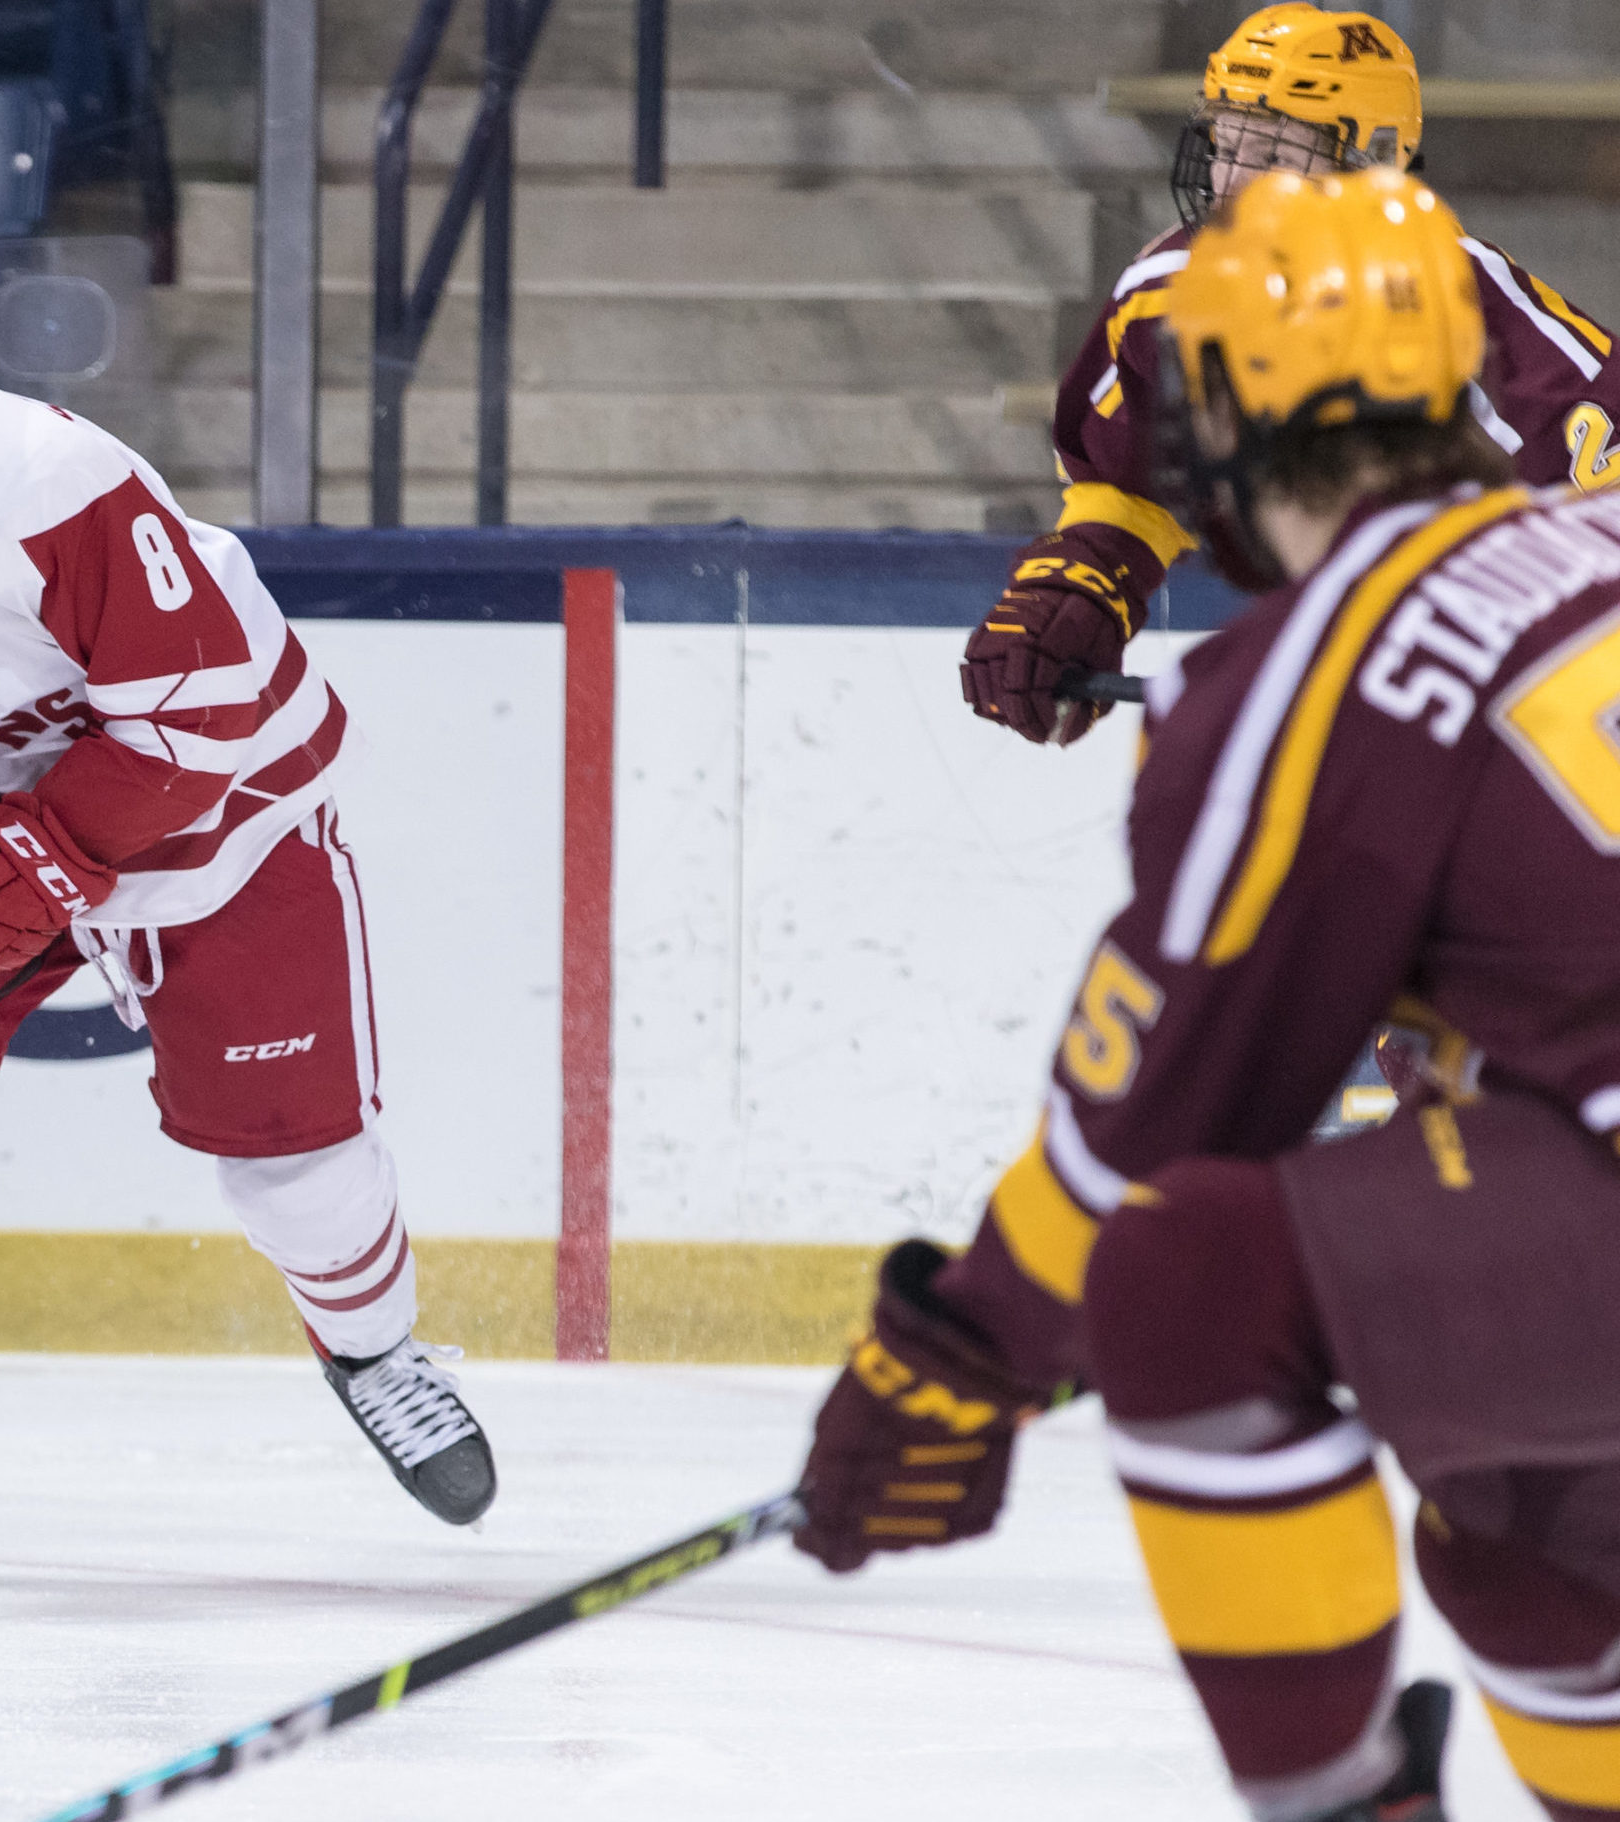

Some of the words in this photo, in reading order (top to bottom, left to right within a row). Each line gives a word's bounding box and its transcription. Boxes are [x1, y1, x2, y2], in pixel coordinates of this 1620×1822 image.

[1338, 23, 1393, 63] M
[132, 513, 193, 612] 8
[224, 1032, 317, 1062] CCM
[1063, 936, 1166, 1102] 5
